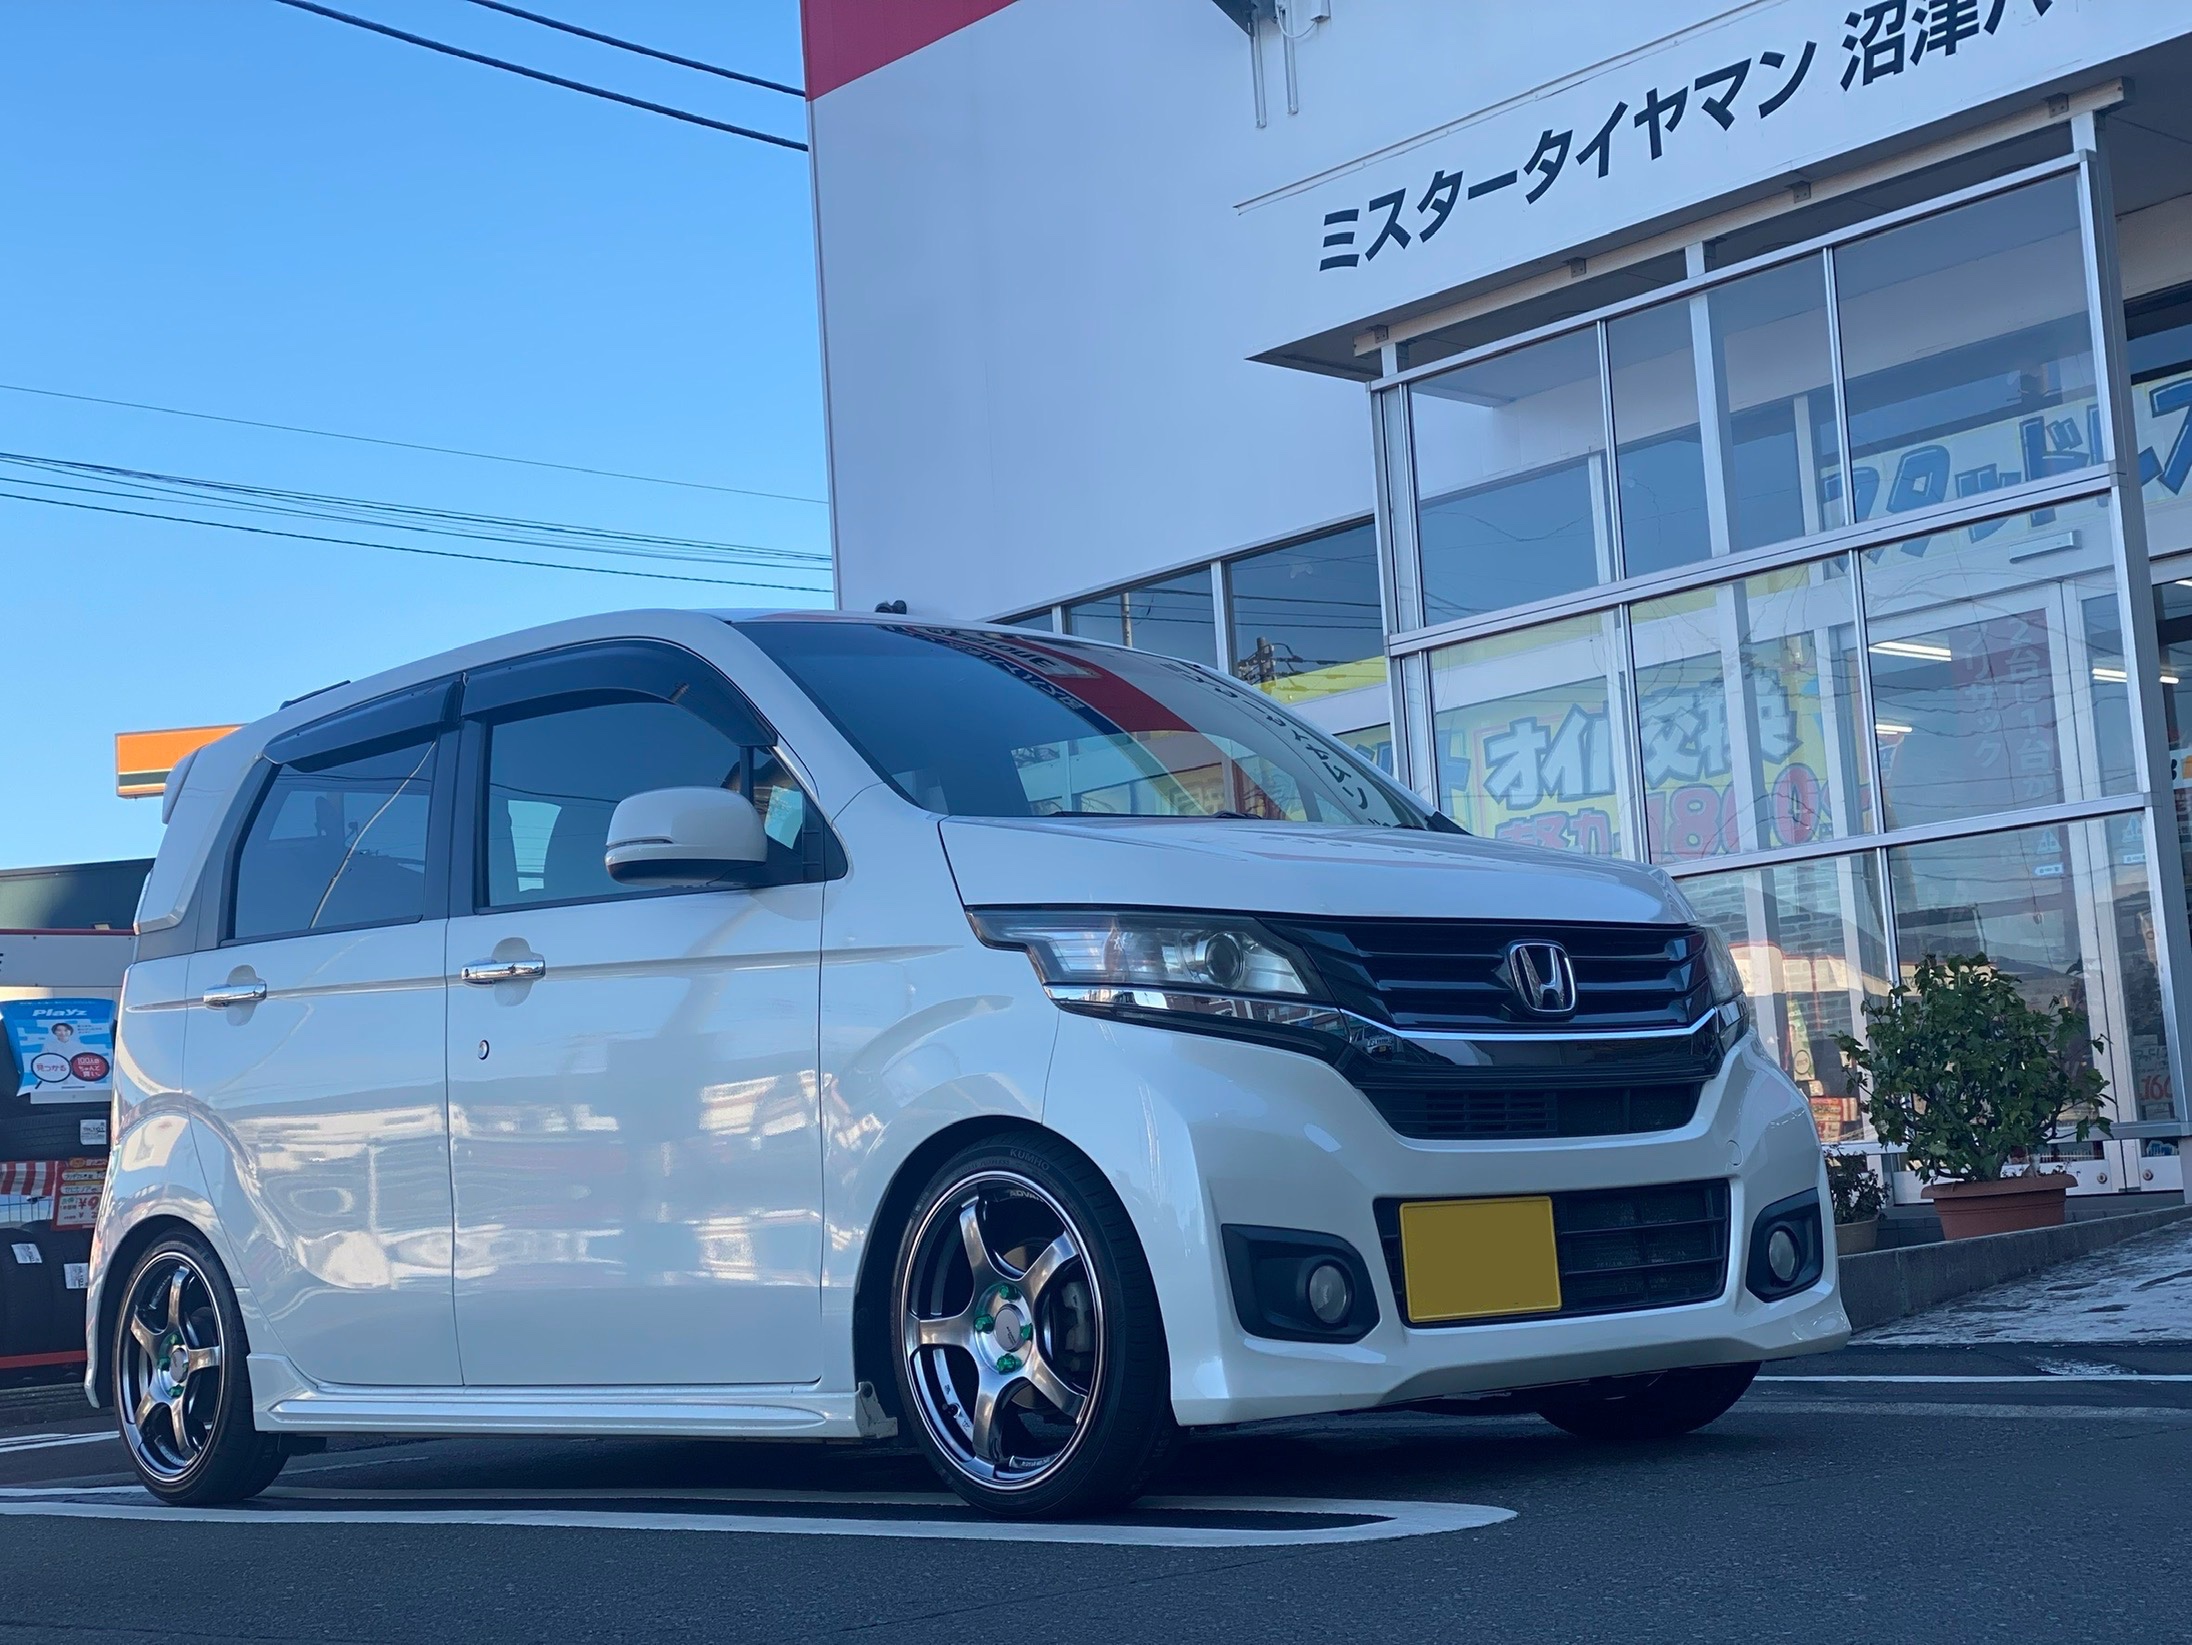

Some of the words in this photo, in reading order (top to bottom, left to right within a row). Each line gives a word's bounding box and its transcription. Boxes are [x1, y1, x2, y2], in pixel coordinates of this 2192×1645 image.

[1318, 41, 1818, 272] ミスタータイヤマン
[32, 1008, 88, 1017] Playz
[1009, 1148, 1051, 1171] KUMHO
